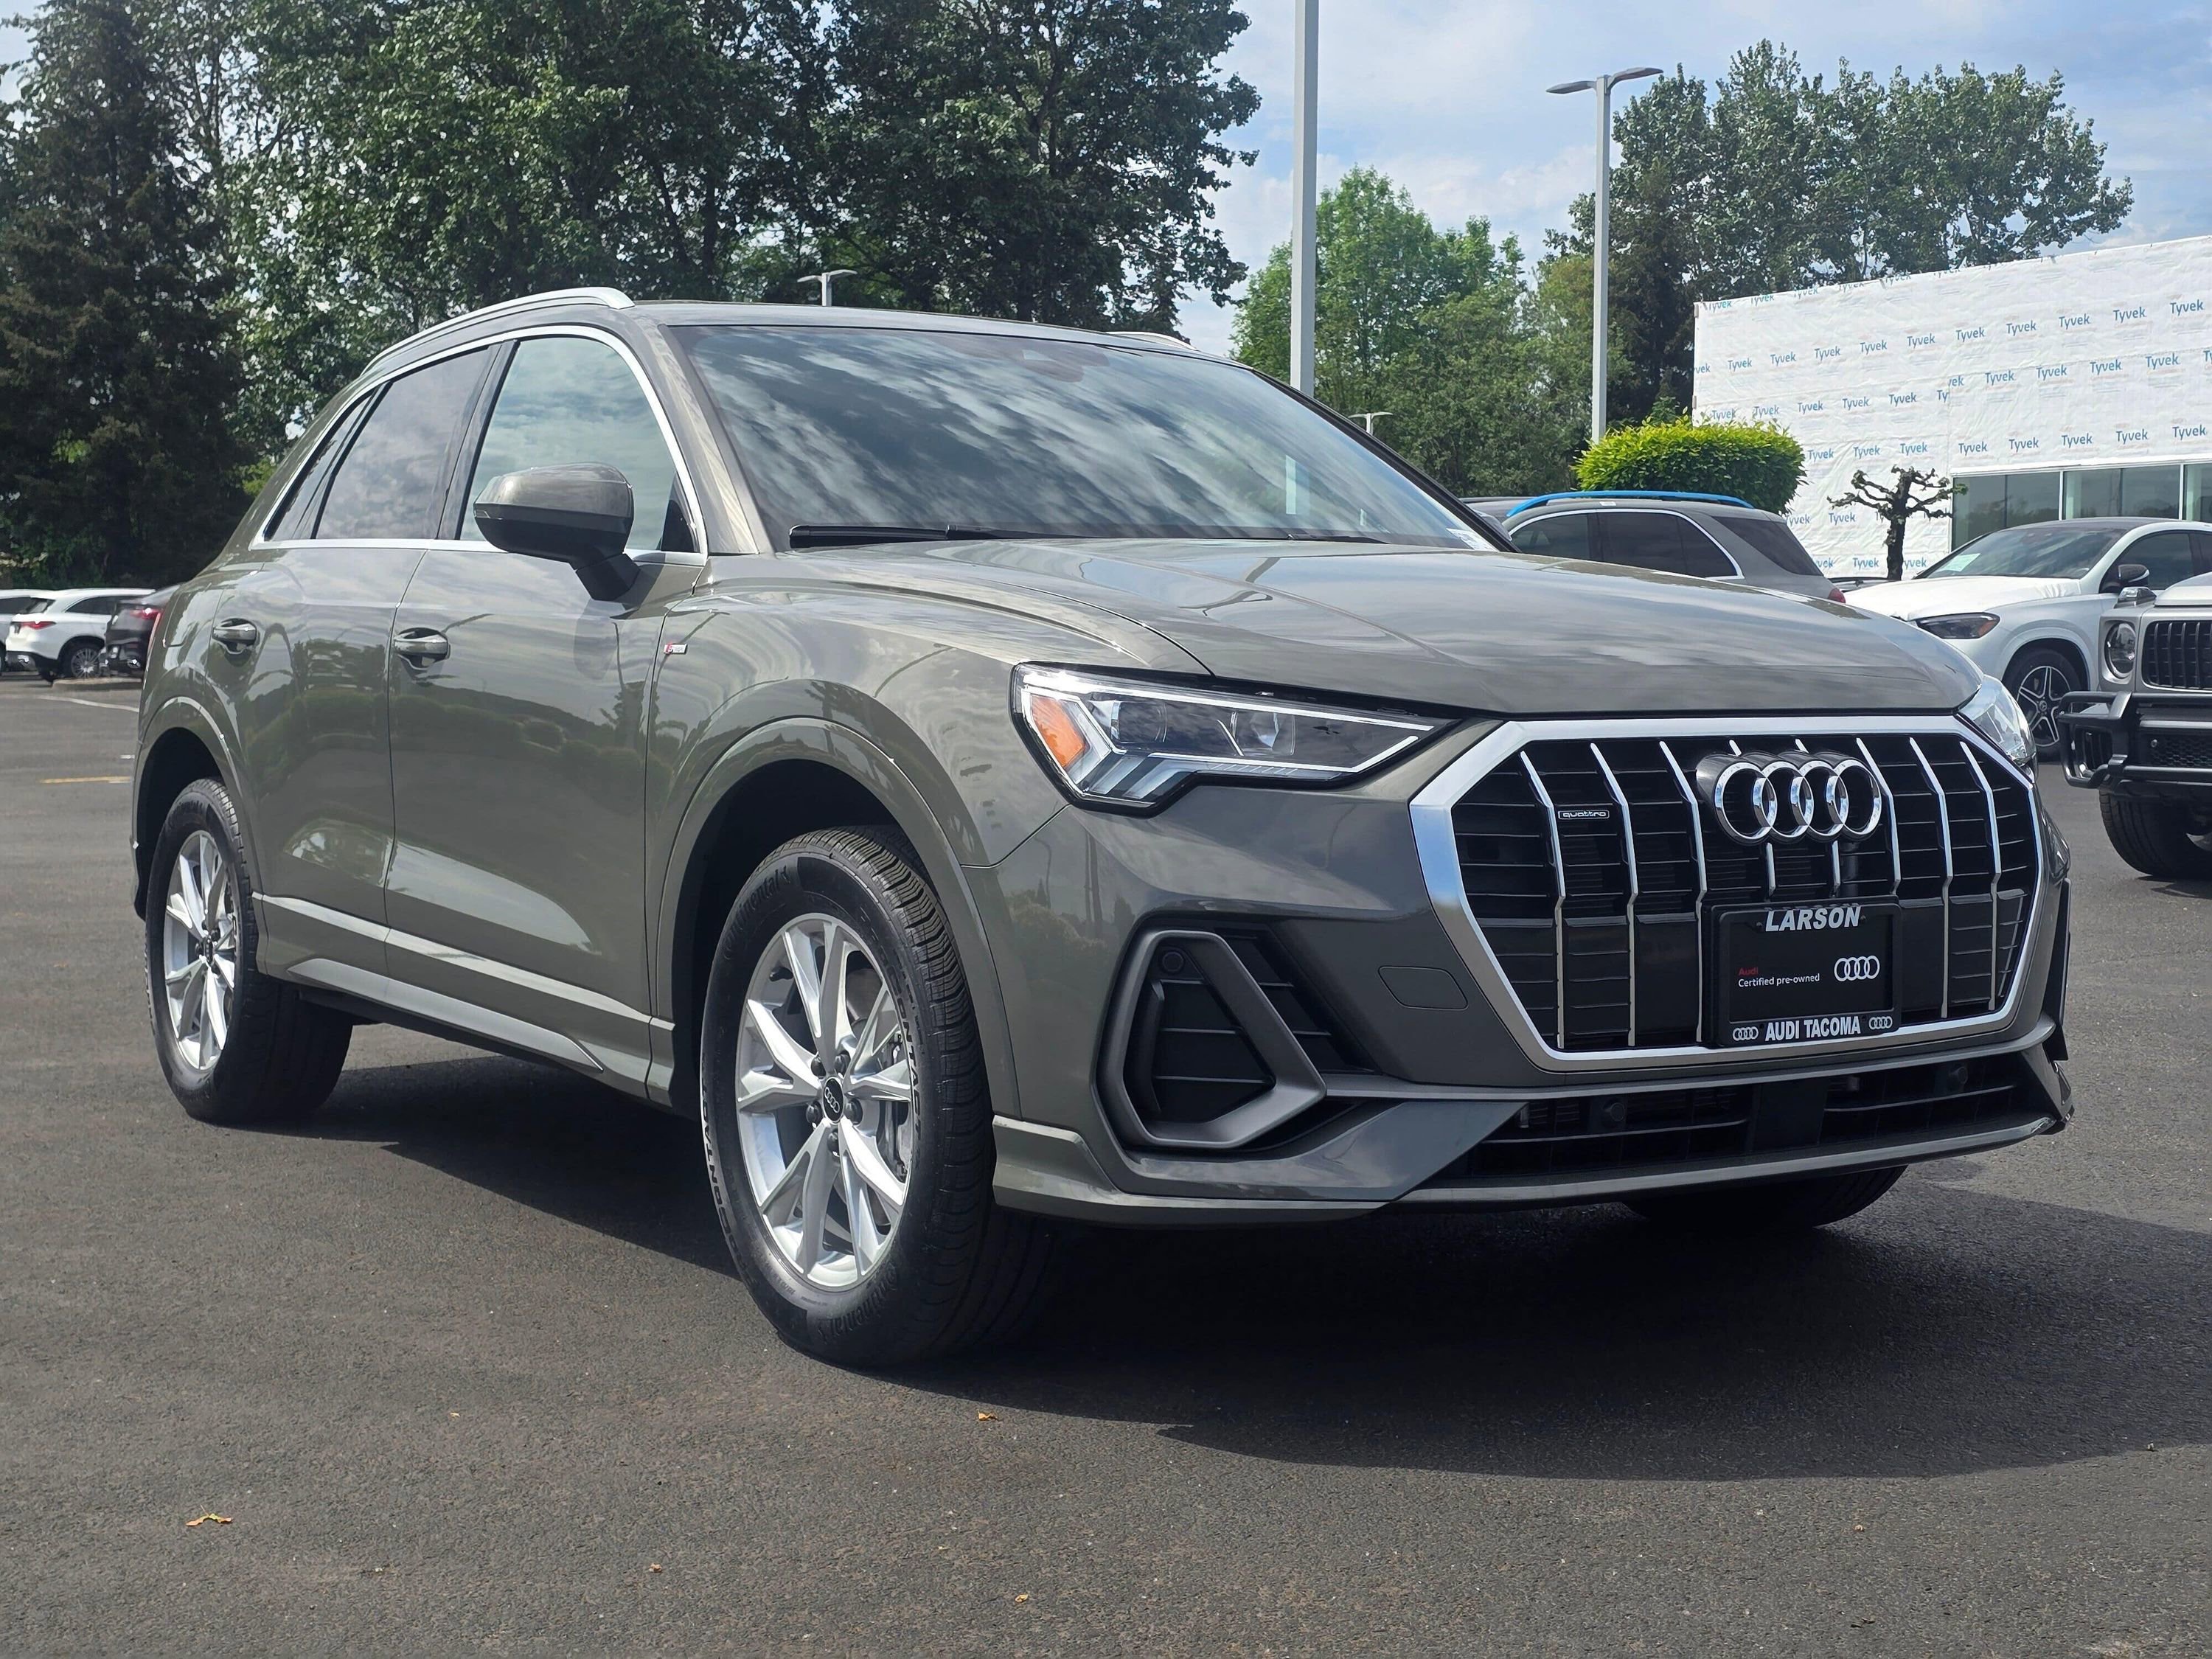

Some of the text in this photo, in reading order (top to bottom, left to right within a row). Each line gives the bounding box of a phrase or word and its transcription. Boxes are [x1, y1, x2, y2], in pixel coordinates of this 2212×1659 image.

[2113, 306, 2146, 323] Tyvek
[2170, 299, 2204, 316] Tyvek
[2006, 320, 2037, 336] Tyvek
[2059, 313, 2090, 330] Tyvek
[1907, 333, 1935, 349] Tyvek
[1955, 327, 1985, 342] Tyvek
[1814, 346, 1840, 361] Tyvek
[1860, 340, 1888, 355] Tyvek
[1728, 358, 1753, 372] Tyvek
[1770, 352, 1797, 366] Tyvek
[2146, 352, 2179, 369] Tyvek
[2037, 364, 2067, 380] Tyvek
[2090, 359, 2121, 375] Tyvek
[1985, 370, 2014, 386] Tyvek
[1798, 400, 1823, 414] Tyvek
[1843, 397, 1869, 411] Tyvek
[1888, 392, 1916, 407] Tyvek
[1711, 409, 1736, 421] Tyvek
[1754, 405, 1780, 418] Tyvek
[2116, 428, 2148, 445] Tyvek
[2172, 425, 2206, 440] Tyvek
[2008, 437, 2039, 452] Tyvek
[2062, 433, 2093, 448] Tyvek
[1808, 448, 1834, 462] Tyvek
[1853, 445, 1879, 459] Tyvek
[1900, 442, 1927, 456] Tyvek
[1958, 441, 1987, 456] Tyvek
[1829, 512, 1856, 525] Tyvek
[1853, 557, 1879, 570] Tyvek
[1903, 557, 1927, 569] yvek
[1765, 906, 1861, 932] LARSON
[1739, 967, 1759, 976] Audi
[1739, 973, 1820, 987] Certified pre-owned
[1764, 1016, 1861, 1041] AUDI TACOMA
